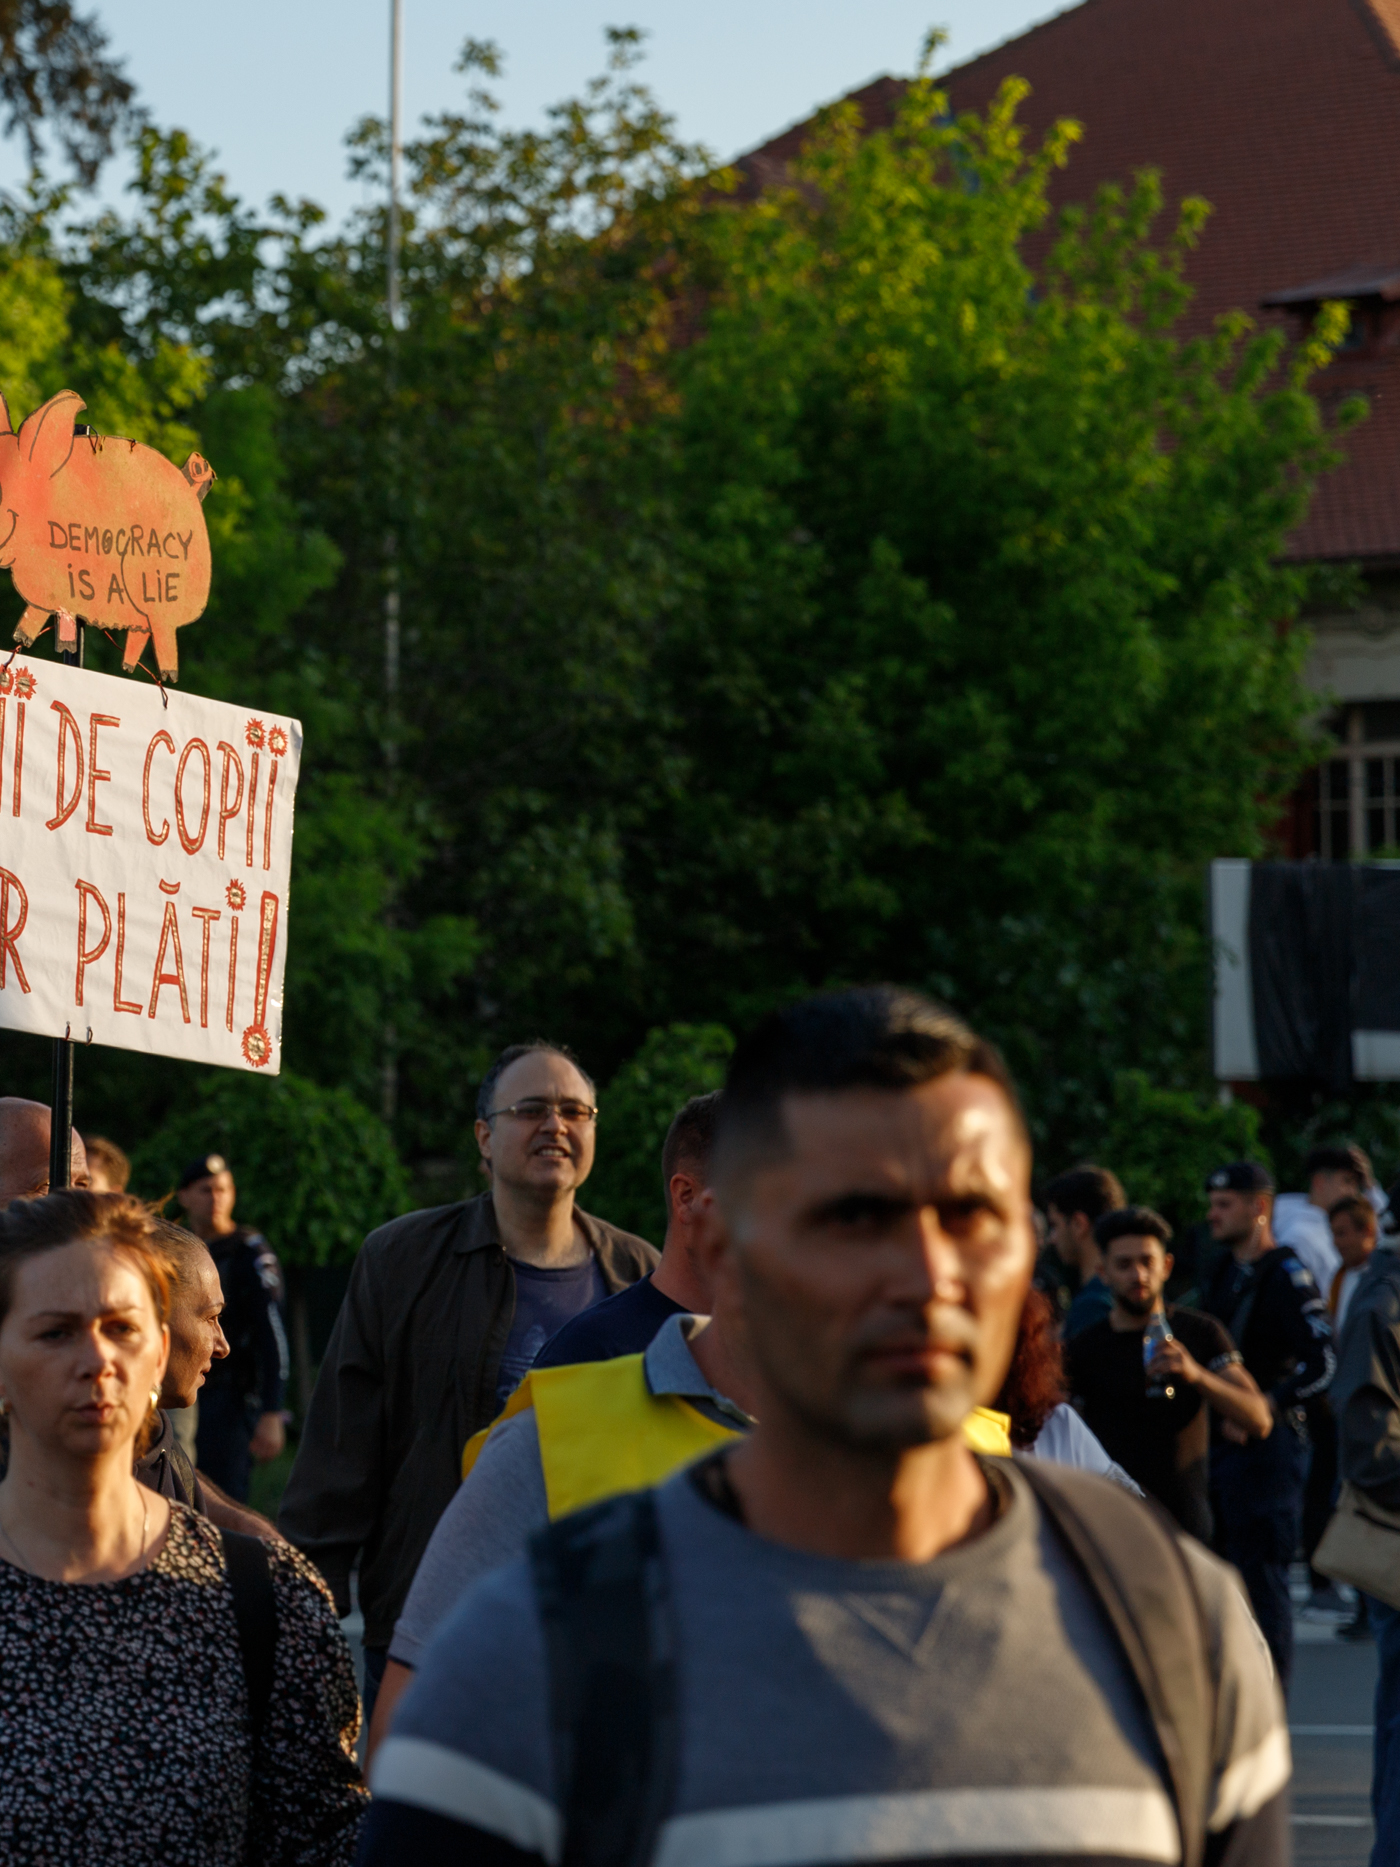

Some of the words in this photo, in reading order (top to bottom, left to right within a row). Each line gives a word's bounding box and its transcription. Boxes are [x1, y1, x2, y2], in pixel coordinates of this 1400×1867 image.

[48, 520, 193, 561] DEMOCRACY
[107, 573, 125, 604] A
[46, 700, 120, 836] DE
